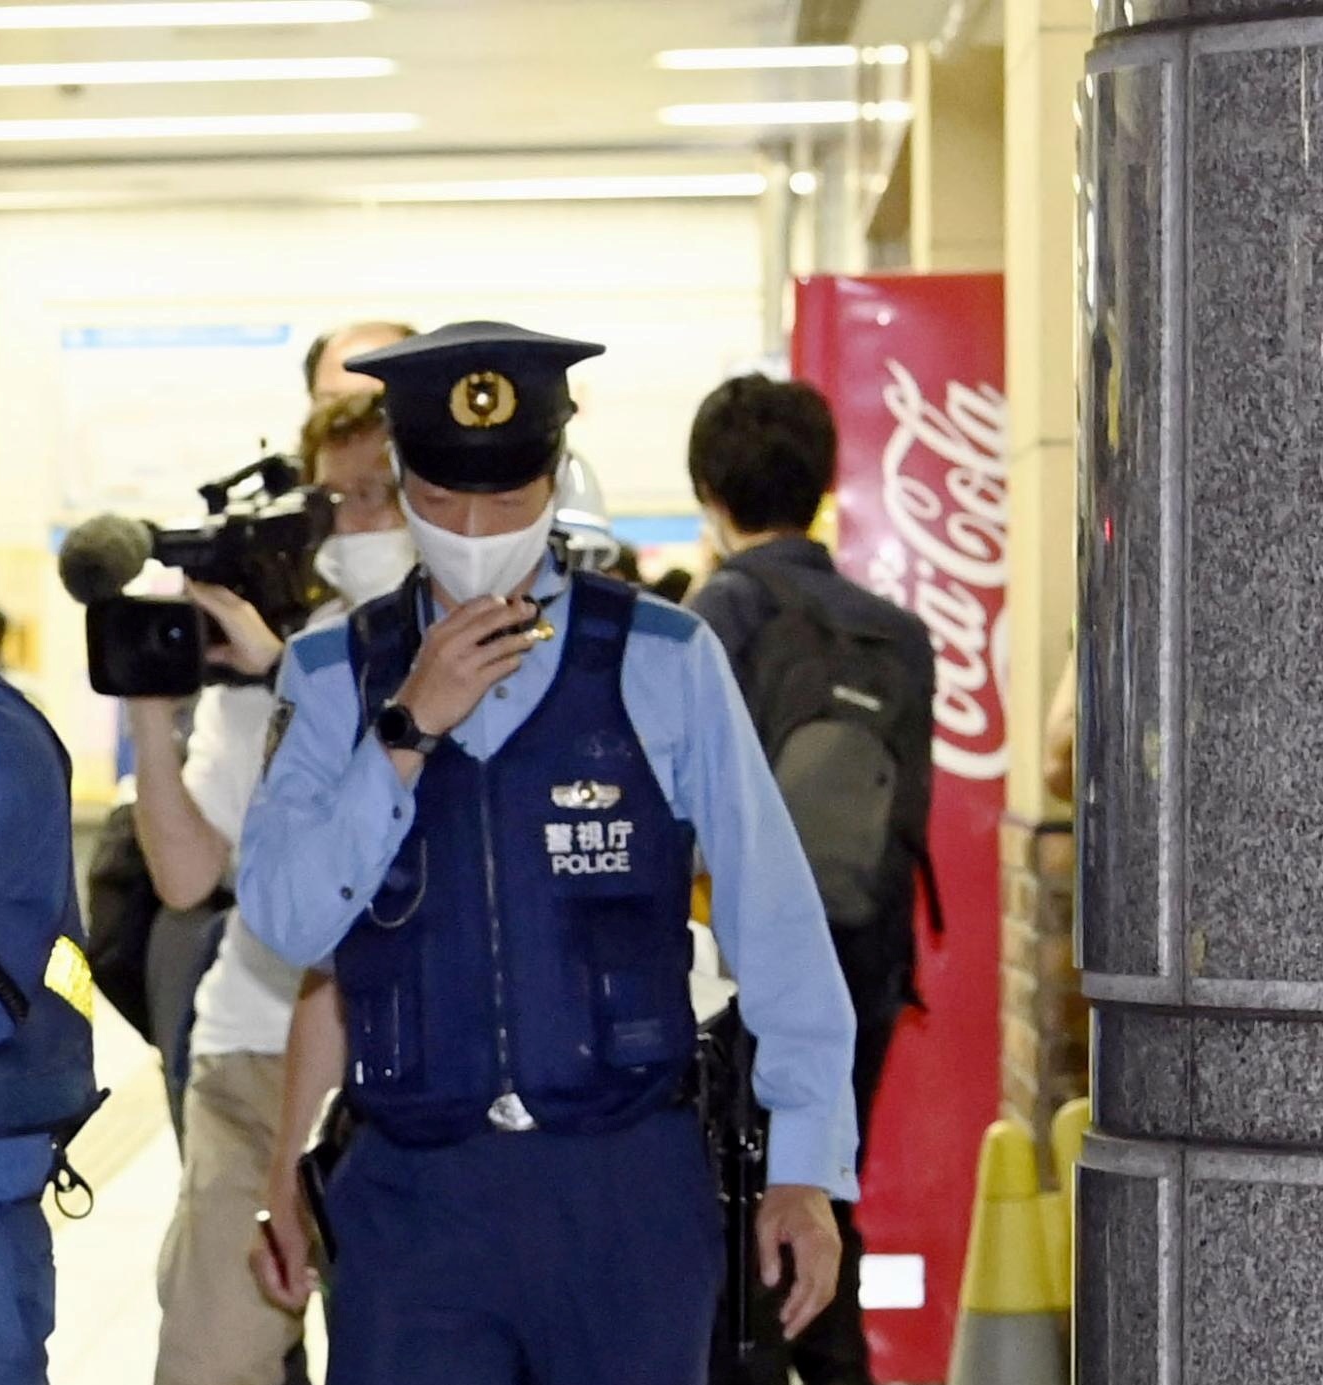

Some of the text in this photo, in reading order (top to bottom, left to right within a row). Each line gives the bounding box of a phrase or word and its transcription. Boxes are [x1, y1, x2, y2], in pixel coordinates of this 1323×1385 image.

[545, 820, 633, 853] 警視庁
[552, 851, 631, 874] POLICE
